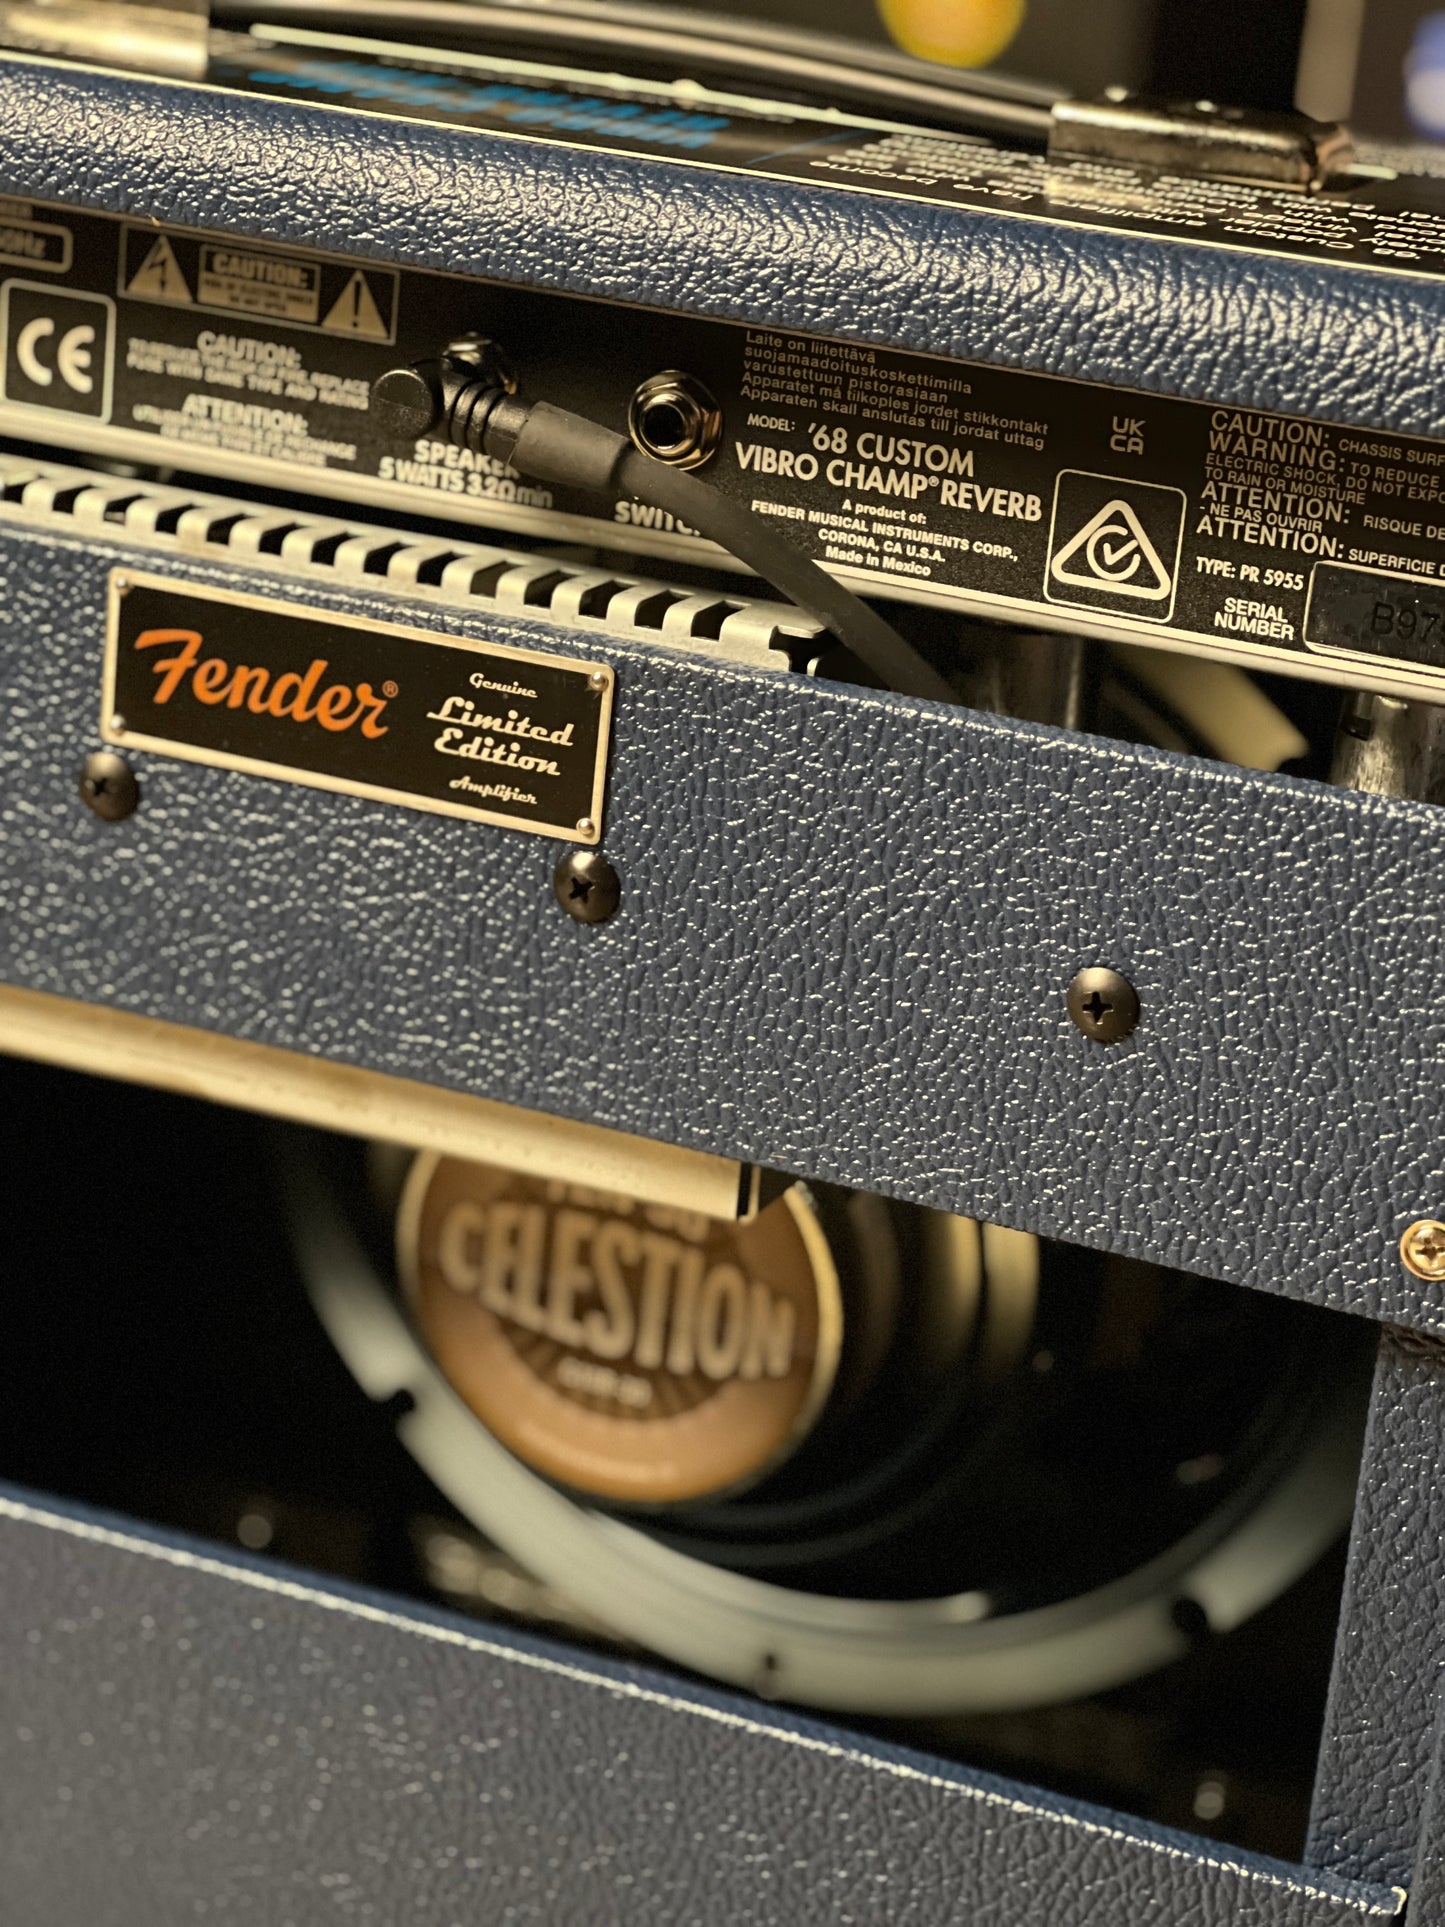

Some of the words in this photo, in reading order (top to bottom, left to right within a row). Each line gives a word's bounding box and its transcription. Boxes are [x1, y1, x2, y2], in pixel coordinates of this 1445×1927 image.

[809, 160, 938, 186] become
[953, 183, 1033, 201] have
[1218, 217, 1347, 239] popular
[1243, 212, 1358, 233] vintage
[1284, 209, 1350, 224] with
[1224, 225, 1355, 249] Custom
[1359, 238, 1445, 254] mely
[212, 253, 310, 288] CAUTION:
[197, 330, 302, 370] CAUTION:
[746, 330, 782, 347] Laite
[787, 340, 806, 351] on
[811, 341, 876, 364] liitettävä
[743, 360, 843, 385] varustettuun
[849, 377, 948, 404] pistorasiaan
[745, 346, 972, 394] suojamaadoituskoskettimilla
[182, 393, 308, 437] ATTENTION:
[740, 385, 818, 408] Apparaten
[822, 400, 857, 415] skall
[862, 407, 926, 428] anslutas
[930, 417, 950, 432] till
[953, 421, 1000, 441] jordat
[1004, 432, 1045, 451] uttag
[742, 371, 815, 395] Apparatet
[819, 385, 842, 399] må
[913, 400, 959, 420] jordet
[963, 411, 1049, 435] stikkontakt
[1112, 415, 1146, 437] UK
[1211, 410, 1330, 448] CAUTION:
[1339, 438, 1402, 460] CHASSIS
[747, 413, 796, 432] MODEL:
[807, 422, 848, 454] '68
[856, 432, 974, 478] CUSTOM
[1110, 434, 1144, 456] CA
[1209, 430, 1346, 473] WARNING:
[1350, 461, 1371, 477] TO
[1374, 466, 1441, 489] REDUCE
[395, 458, 465, 493] WATTS
[735, 441, 819, 481] VIBRO
[940, 478, 1042, 522] REVERB
[1204, 466, 1224, 481] TO
[1227, 470, 1262, 487] RAIN
[1265, 477, 1287, 492] OR
[1290, 481, 1366, 505] MOISTURE
[1206, 452, 1280, 476] ELECTRIC
[1283, 465, 1341, 488] SHOCK,
[1345, 476, 1368, 491] DO
[1371, 480, 1405, 497] NOT
[614, 500, 701, 537] SWIT
[842, 499, 852, 511] A
[855, 503, 907, 521] product
[908, 512, 927, 525] of:
[1200, 480, 1350, 524] ATTENTION:
[1363, 514, 1423, 537] RISQUE
[1210, 502, 1231, 517] NE
[1234, 506, 1262, 523] PAS
[1266, 512, 1323, 534] OUVRIR
[751, 499, 806, 520] FENDER
[808, 510, 869, 532] MUSICAL
[872, 522, 970, 551] INSTRUMENTS
[972, 541, 1018, 562] CORP.,
[818, 528, 880, 552] CORONA,
[883, 541, 903, 555] CA
[905, 544, 946, 563] U.S.A.
[1196, 514, 1344, 559] ATTENTION:
[1348, 548, 1436, 575] SUPERFICIE
[825, 545, 864, 564] Made
[866, 553, 880, 567] in
[882, 556, 932, 577] Mexico
[1196, 556, 1236, 578] TYPE:
[1239, 564, 1260, 583] PR
[1263, 568, 1305, 591] 5955
[1214, 611, 1295, 641] NUMBER
[1223, 596, 1289, 624] SERIAL
[1370, 600, 1445, 643] B97
[469, 672, 538, 699] Genuine
[426, 696, 575, 747] Limited
[433, 728, 562, 777] Edition
[448, 775, 539, 806] Amplifier
[438, 1199, 798, 1381] CELESTION
